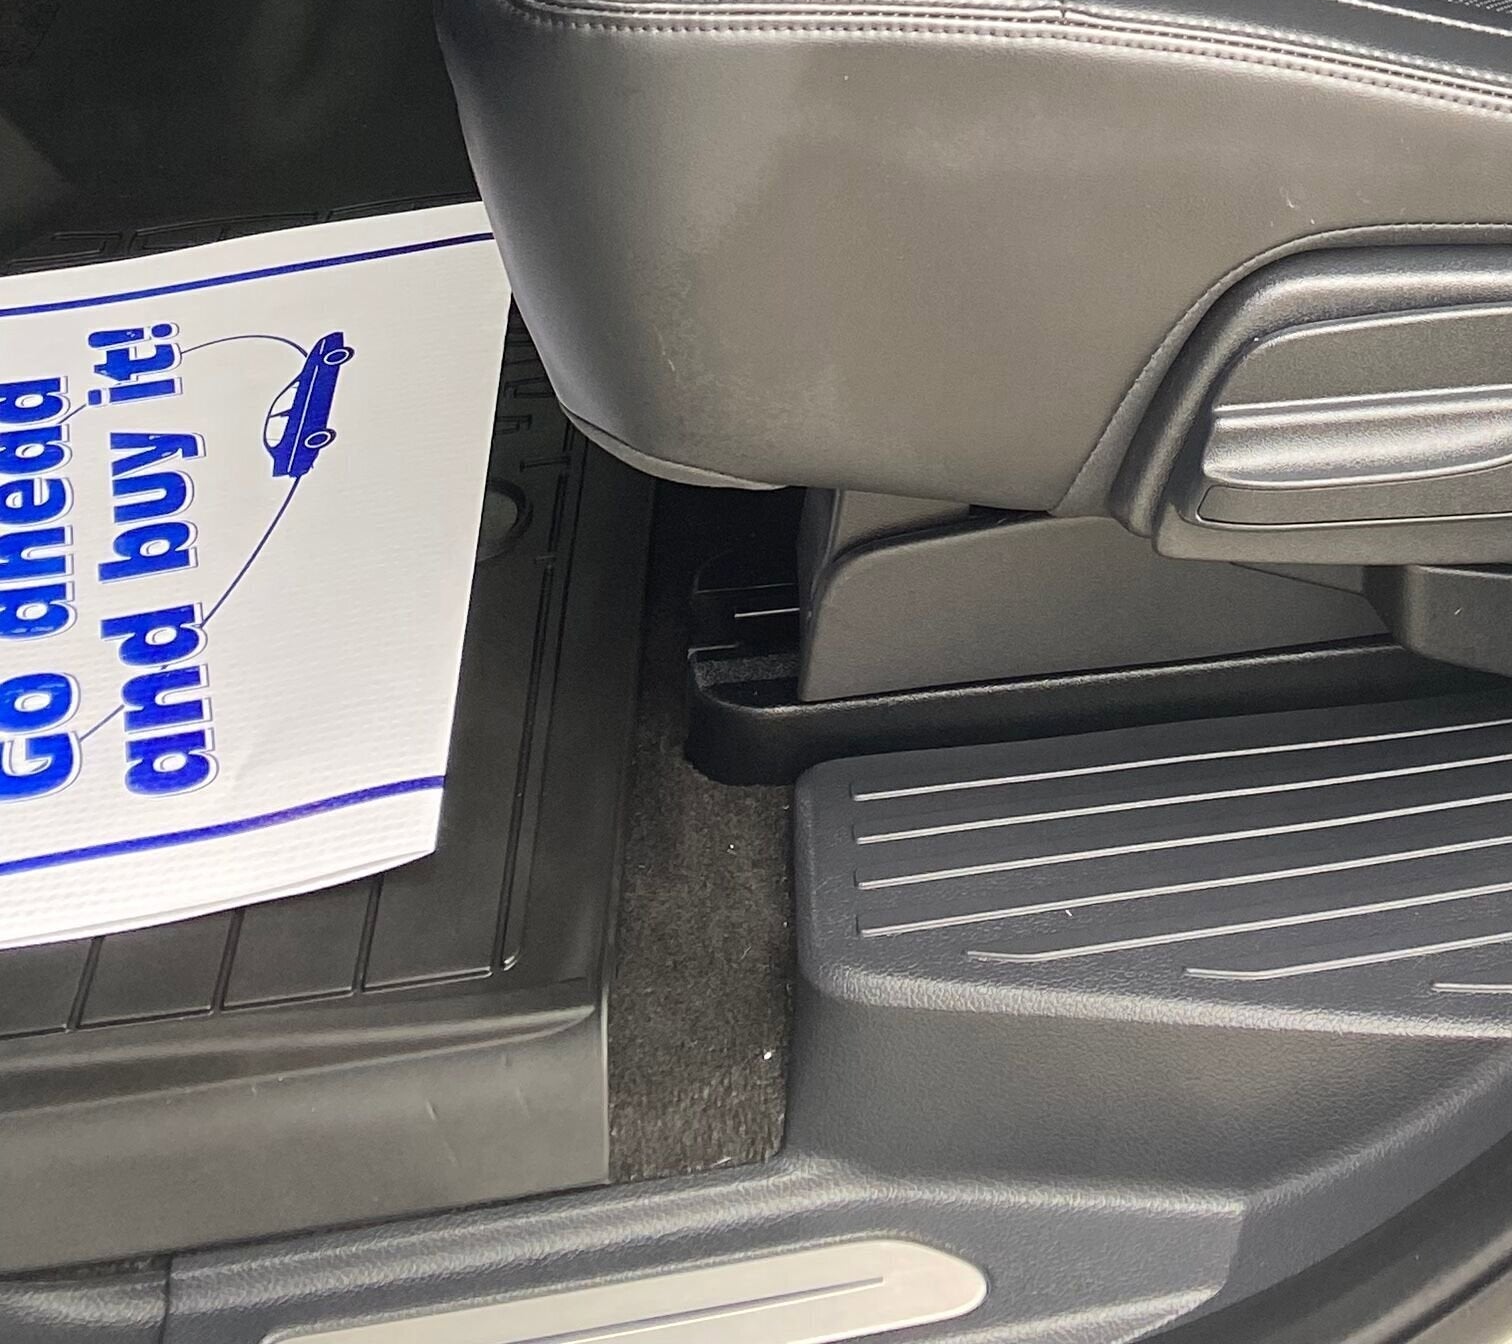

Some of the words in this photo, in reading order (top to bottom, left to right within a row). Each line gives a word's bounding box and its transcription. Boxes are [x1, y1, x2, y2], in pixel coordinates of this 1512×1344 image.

[87, 322, 181, 405] it!
[0, 376, 76, 641] ahead
[98, 431, 205, 584] buy
[0, 672, 80, 803] Go
[100, 603, 217, 797] and
